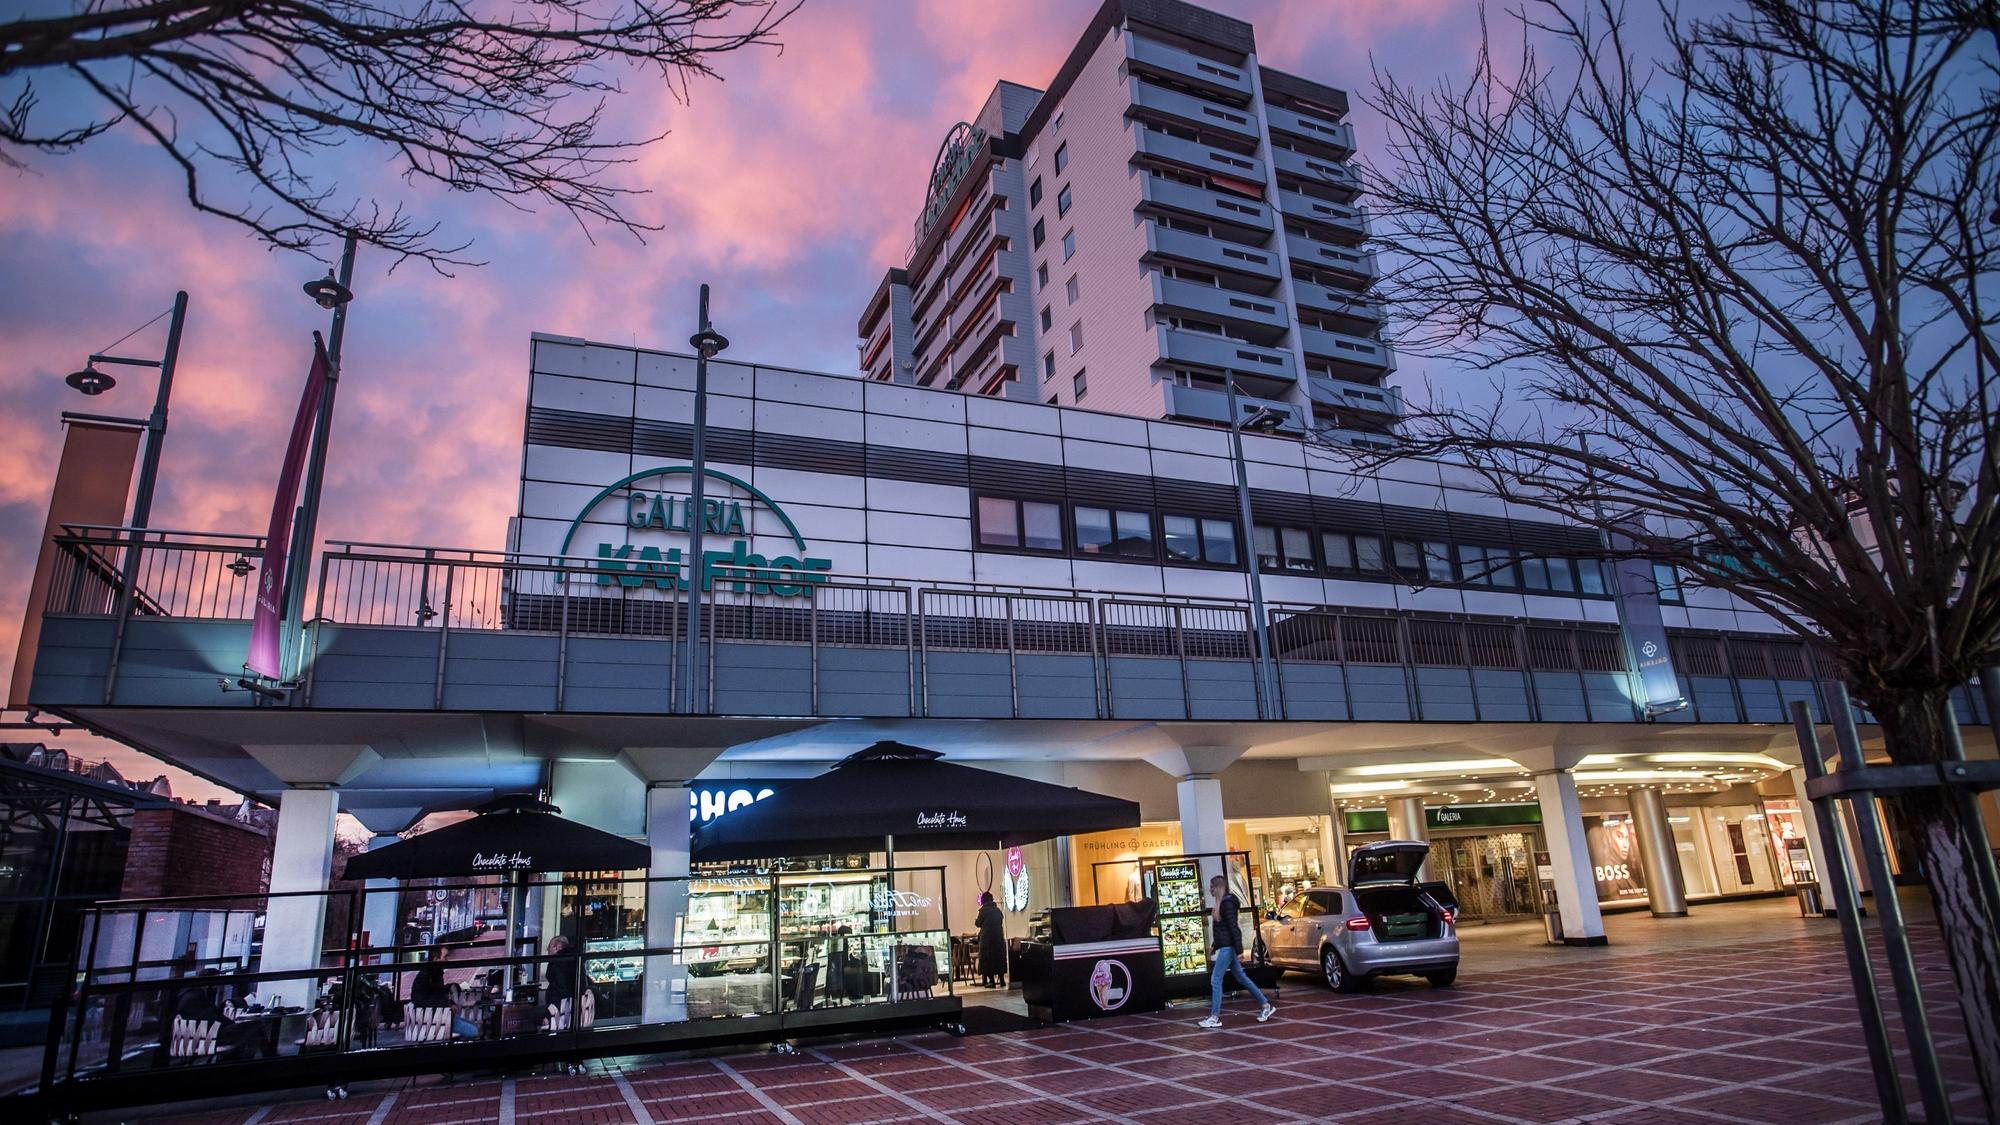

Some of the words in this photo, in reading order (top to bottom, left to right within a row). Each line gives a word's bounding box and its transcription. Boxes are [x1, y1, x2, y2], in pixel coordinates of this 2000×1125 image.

[917, 811, 945, 826] Chocolate
[1440, 811, 1461, 822] GALERIA
[1084, 841, 1126, 850] FRÜHLING
[1142, 839, 1179, 848] GALERIA
[472, 852, 507, 867] Chocolate
[1595, 863, 1630, 881] BOSS
